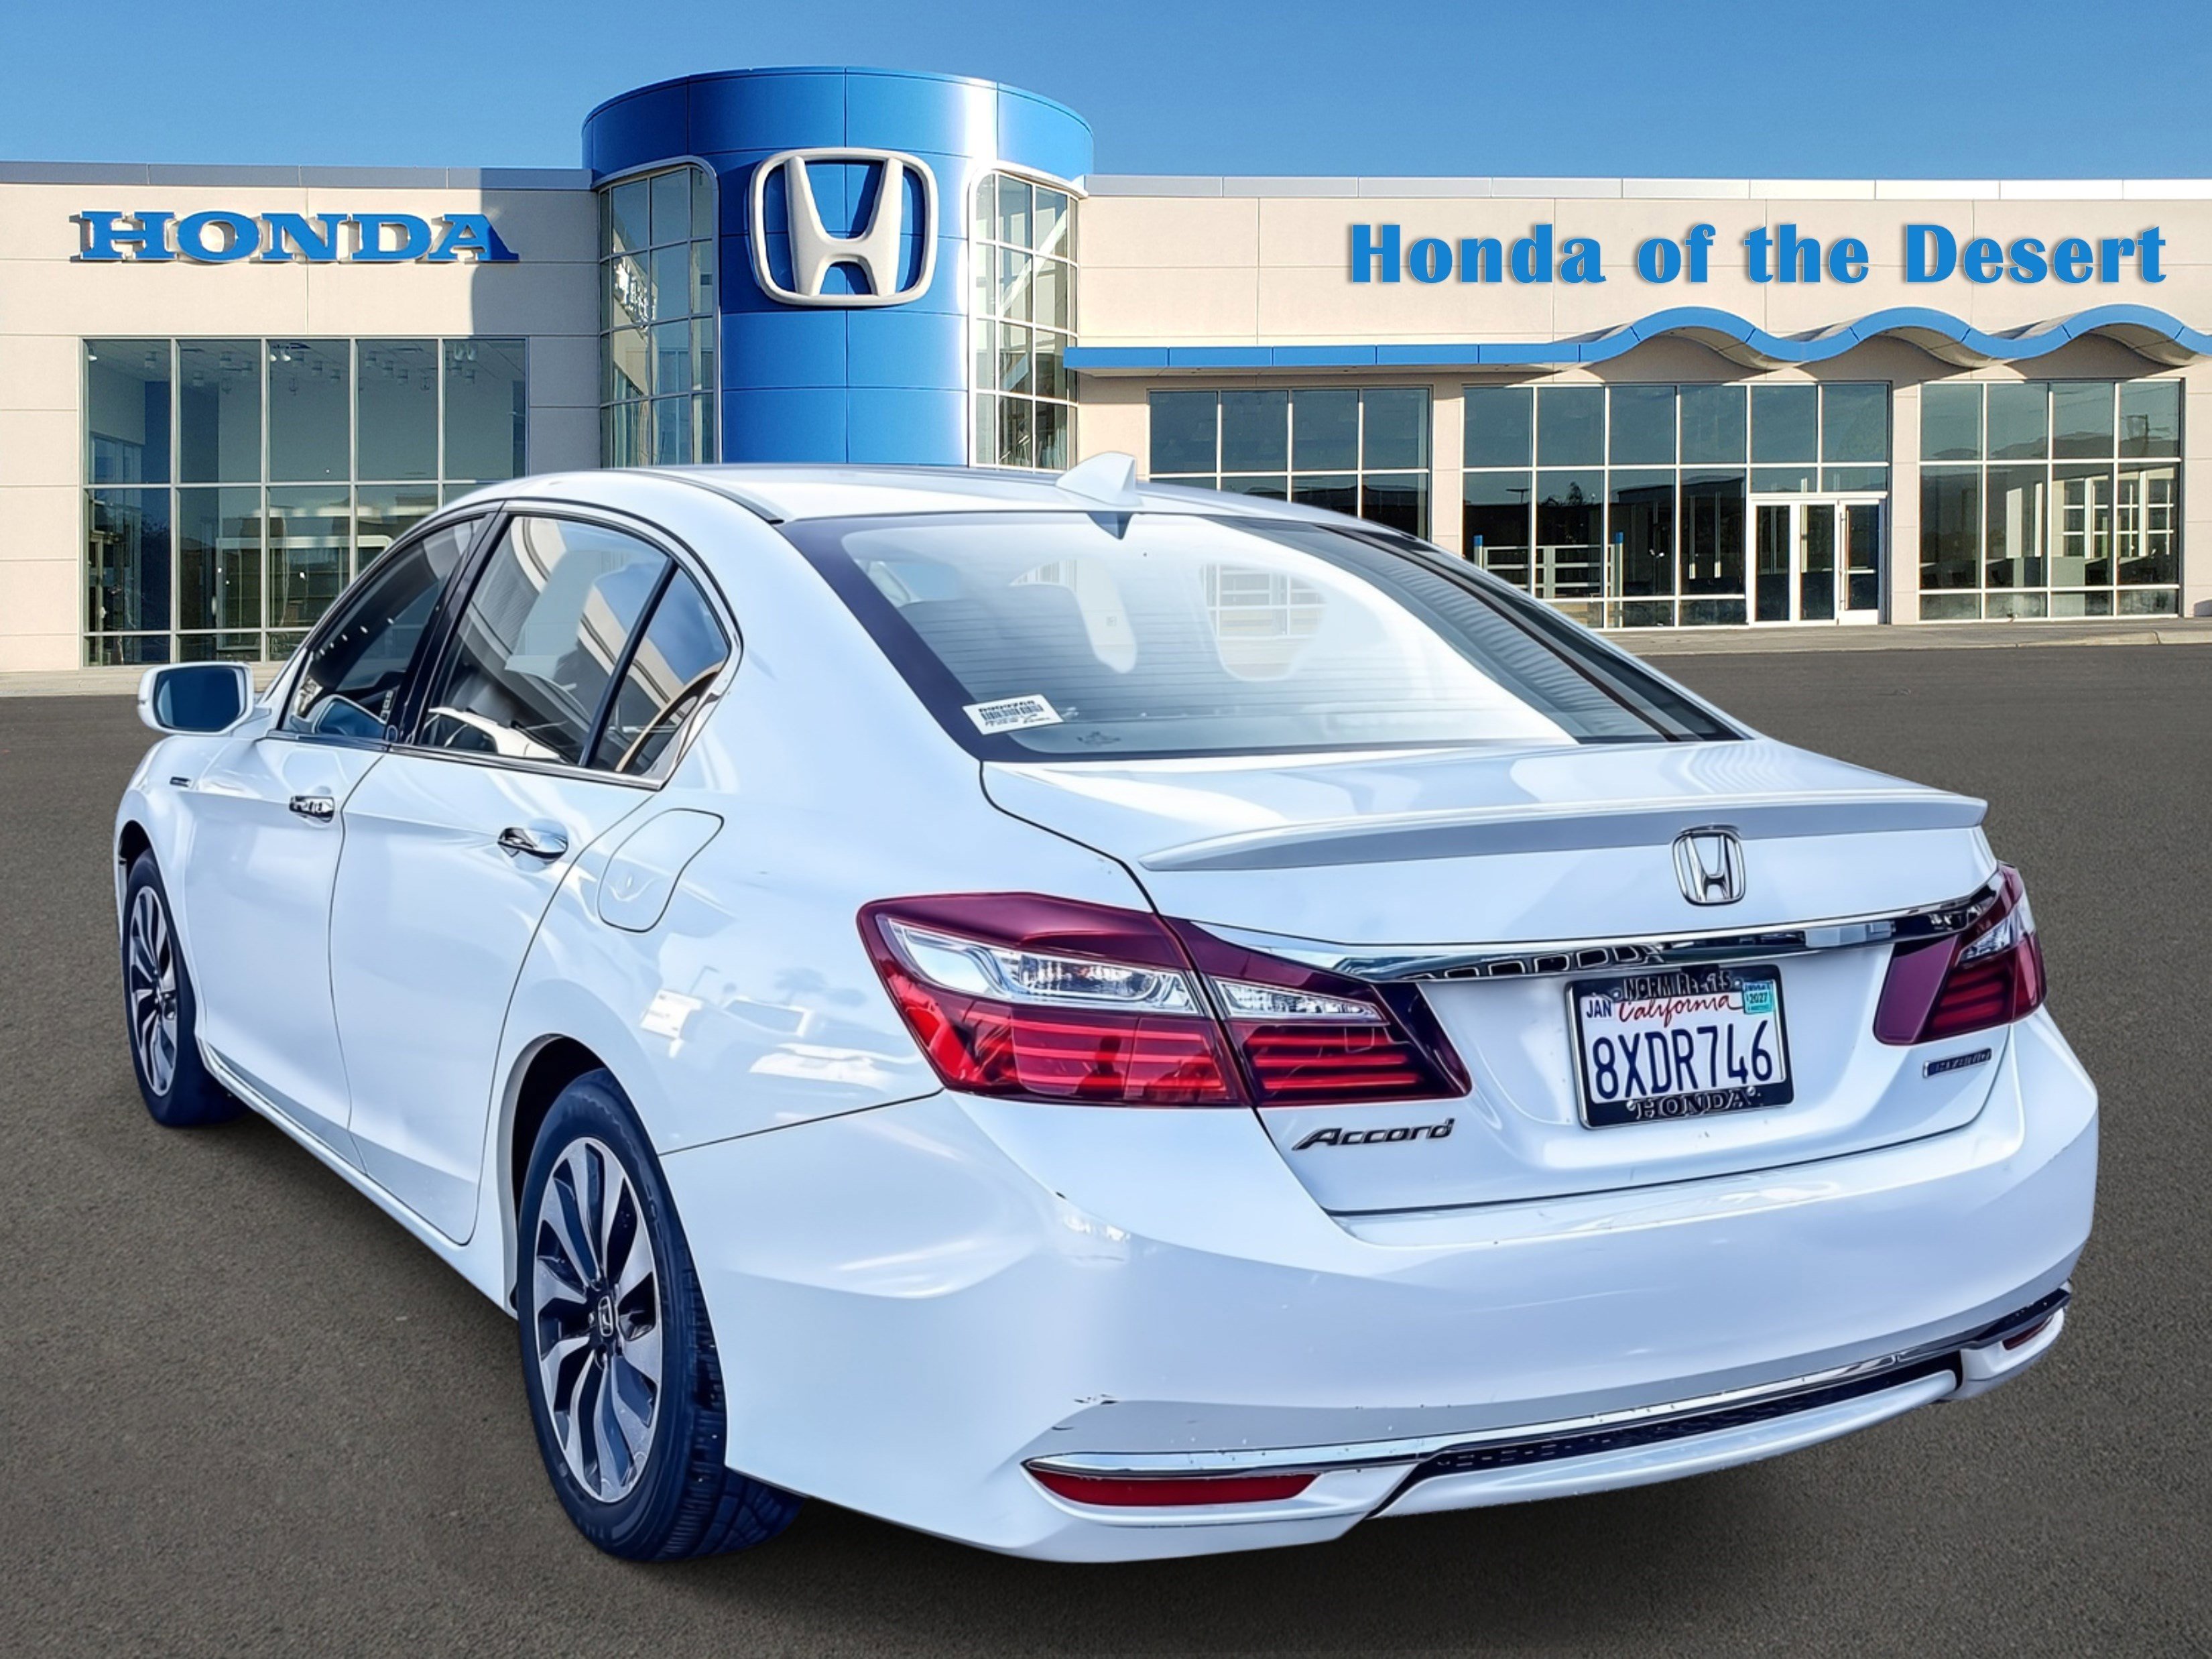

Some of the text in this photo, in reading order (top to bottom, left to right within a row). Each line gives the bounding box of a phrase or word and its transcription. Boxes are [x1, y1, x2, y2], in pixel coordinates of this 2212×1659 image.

[75, 210, 520, 263] HONDA
[1351, 223, 2167, 284] Honda of the Desert
[1623, 973, 1674, 1000] NORM
[1586, 993, 1744, 1028] JAN California
[1592, 1019, 1774, 1100] 8XDR746
[1636, 1087, 1752, 1120] HONDA
[1291, 1117, 1455, 1151] Accord
